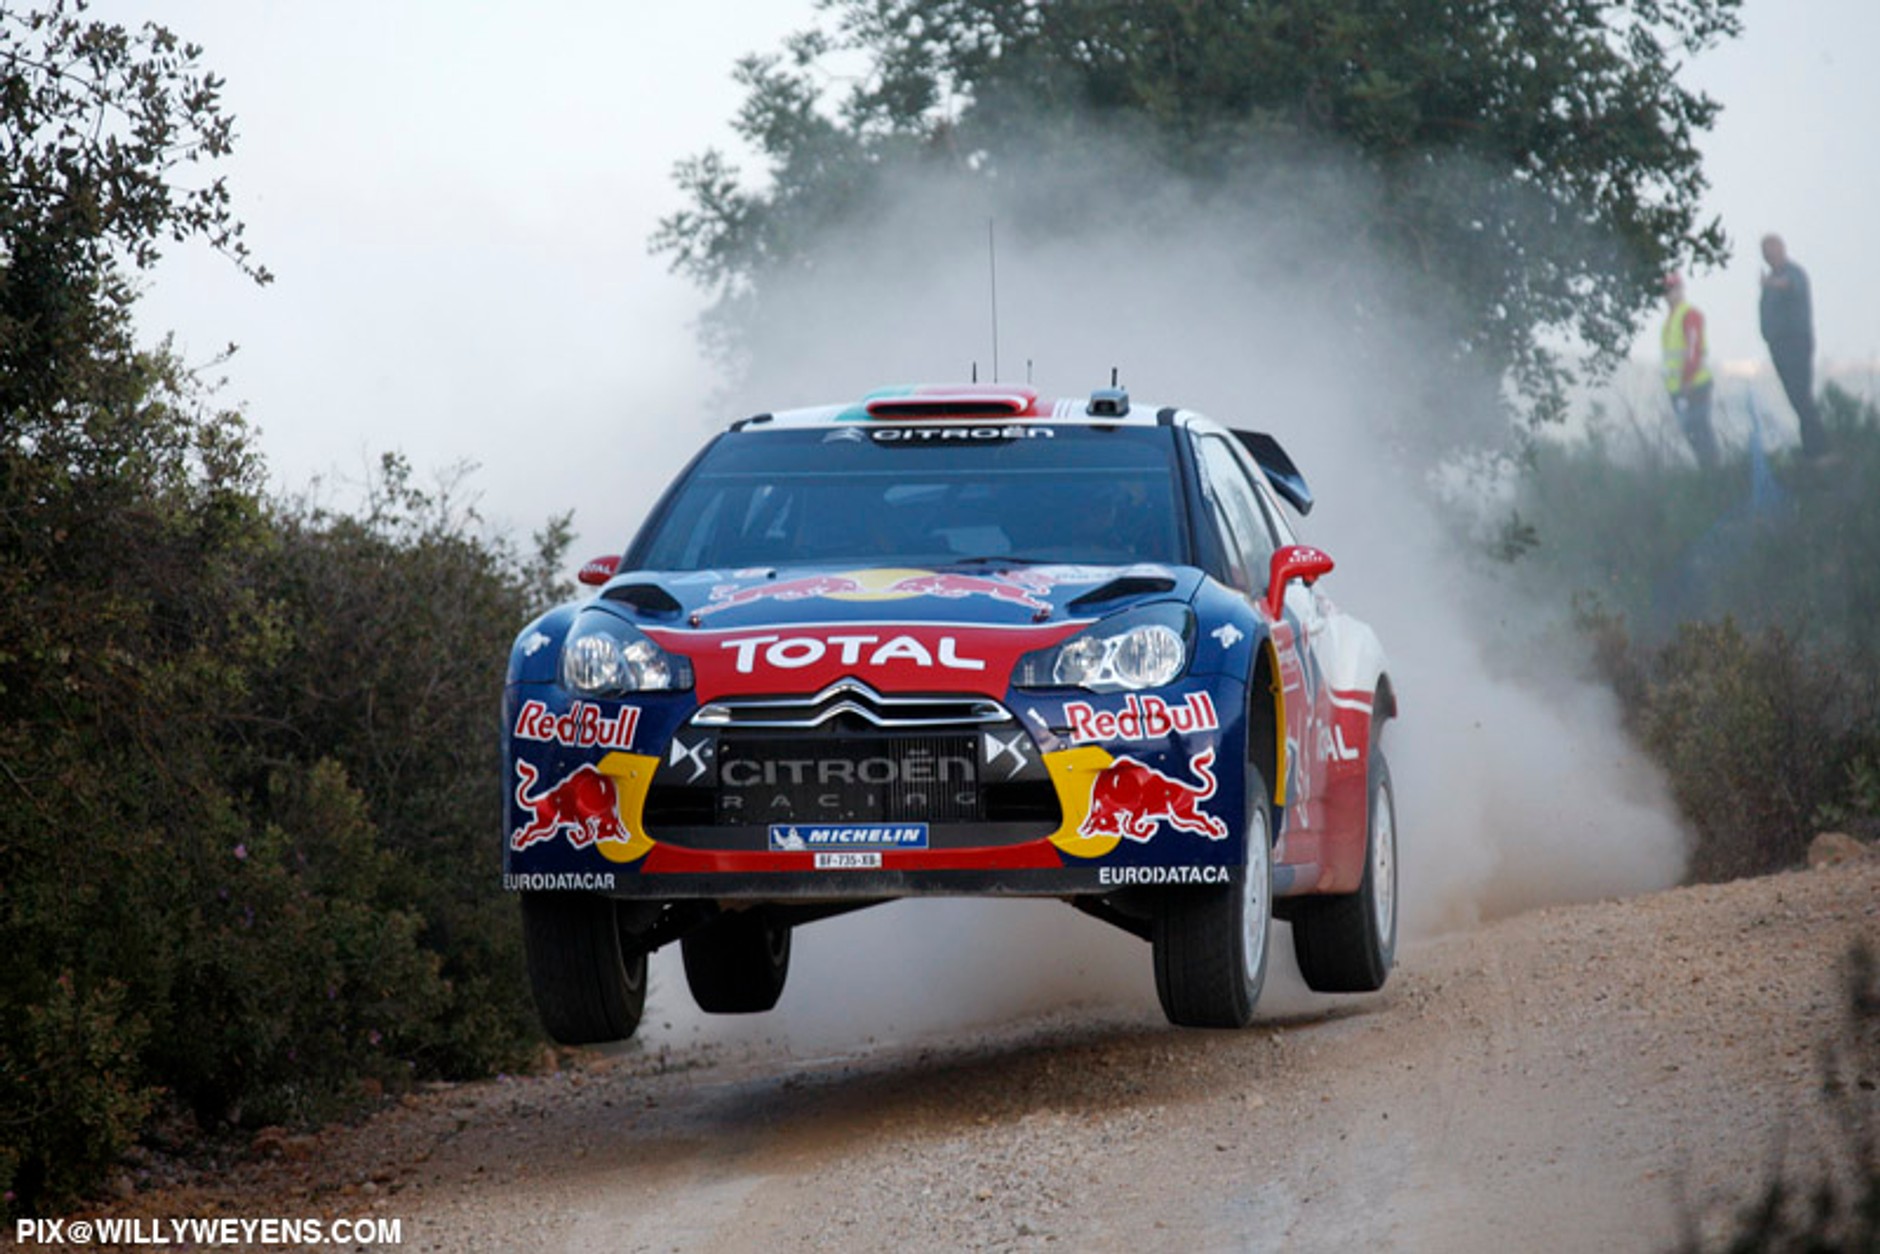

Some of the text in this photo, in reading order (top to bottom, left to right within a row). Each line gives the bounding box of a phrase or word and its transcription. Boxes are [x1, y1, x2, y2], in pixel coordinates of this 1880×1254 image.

[721, 634, 986, 673] TOTAL
[514, 699, 641, 749] Red Bull
[1063, 690, 1218, 744] Red Bull
[722, 792, 977, 809] RACING
[808, 828, 921, 843] MICHELIN
[503, 873, 615, 890] EURODATACAR
